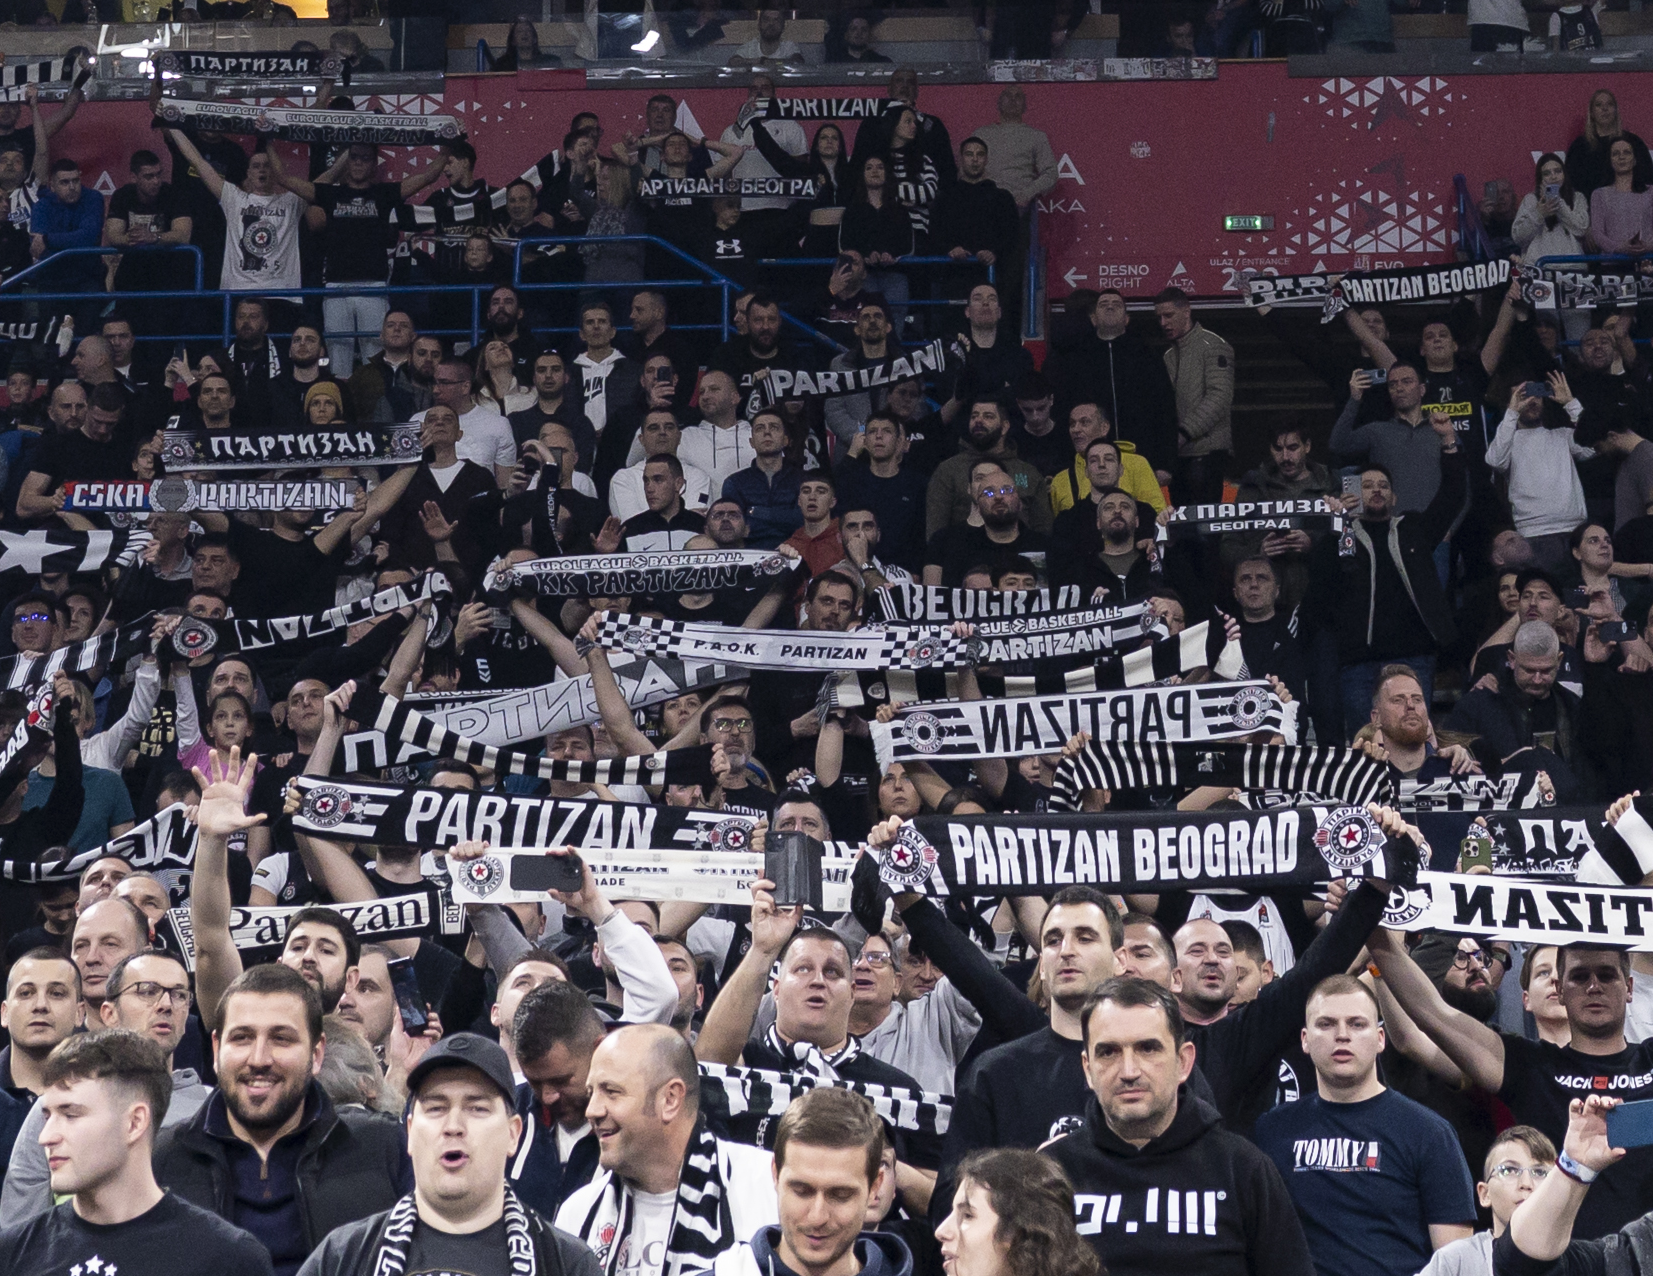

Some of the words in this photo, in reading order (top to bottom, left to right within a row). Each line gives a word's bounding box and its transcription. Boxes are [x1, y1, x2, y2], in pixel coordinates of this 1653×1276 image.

[189, 54, 307, 76] ПАРТИЗАН
[777, 97, 885, 119] PARTIZAN
[1232, 218, 1256, 227] EXIT
[1097, 264, 1148, 276] DESNO
[1097, 278, 1142, 291] RIGHT
[1344, 273, 1423, 307] PARTIZAN
[1425, 258, 1510, 298] BEOGRAD
[769, 345, 933, 400] PARTIZAN
[208, 429, 378, 459] ПАРТИЗАН
[72, 481, 147, 510] CSKA
[199, 480, 349, 511] PARTIZAN
[1209, 518, 1293, 533] БЕОГРАД
[531, 553, 631, 573] EUROLEAGUE
[646, 549, 744, 568] BASKETBALL
[536, 571, 578, 597] KK
[582, 563, 740, 597] PARTIZAN
[1027, 607, 1124, 631] BASKETBALL
[693, 639, 760, 657] P.A.O.K.
[780, 644, 869, 661] PARTIZAN
[981, 628, 1114, 662] PARTIZAN
[405, 790, 657, 853] PARTIZAN
[948, 820, 1121, 890] PARTIZAN
[1134, 809, 1301, 883] BEOGRAD
[1552, 1074, 1592, 1090] JACK
[1291, 1137, 1364, 1170] TOMMY
